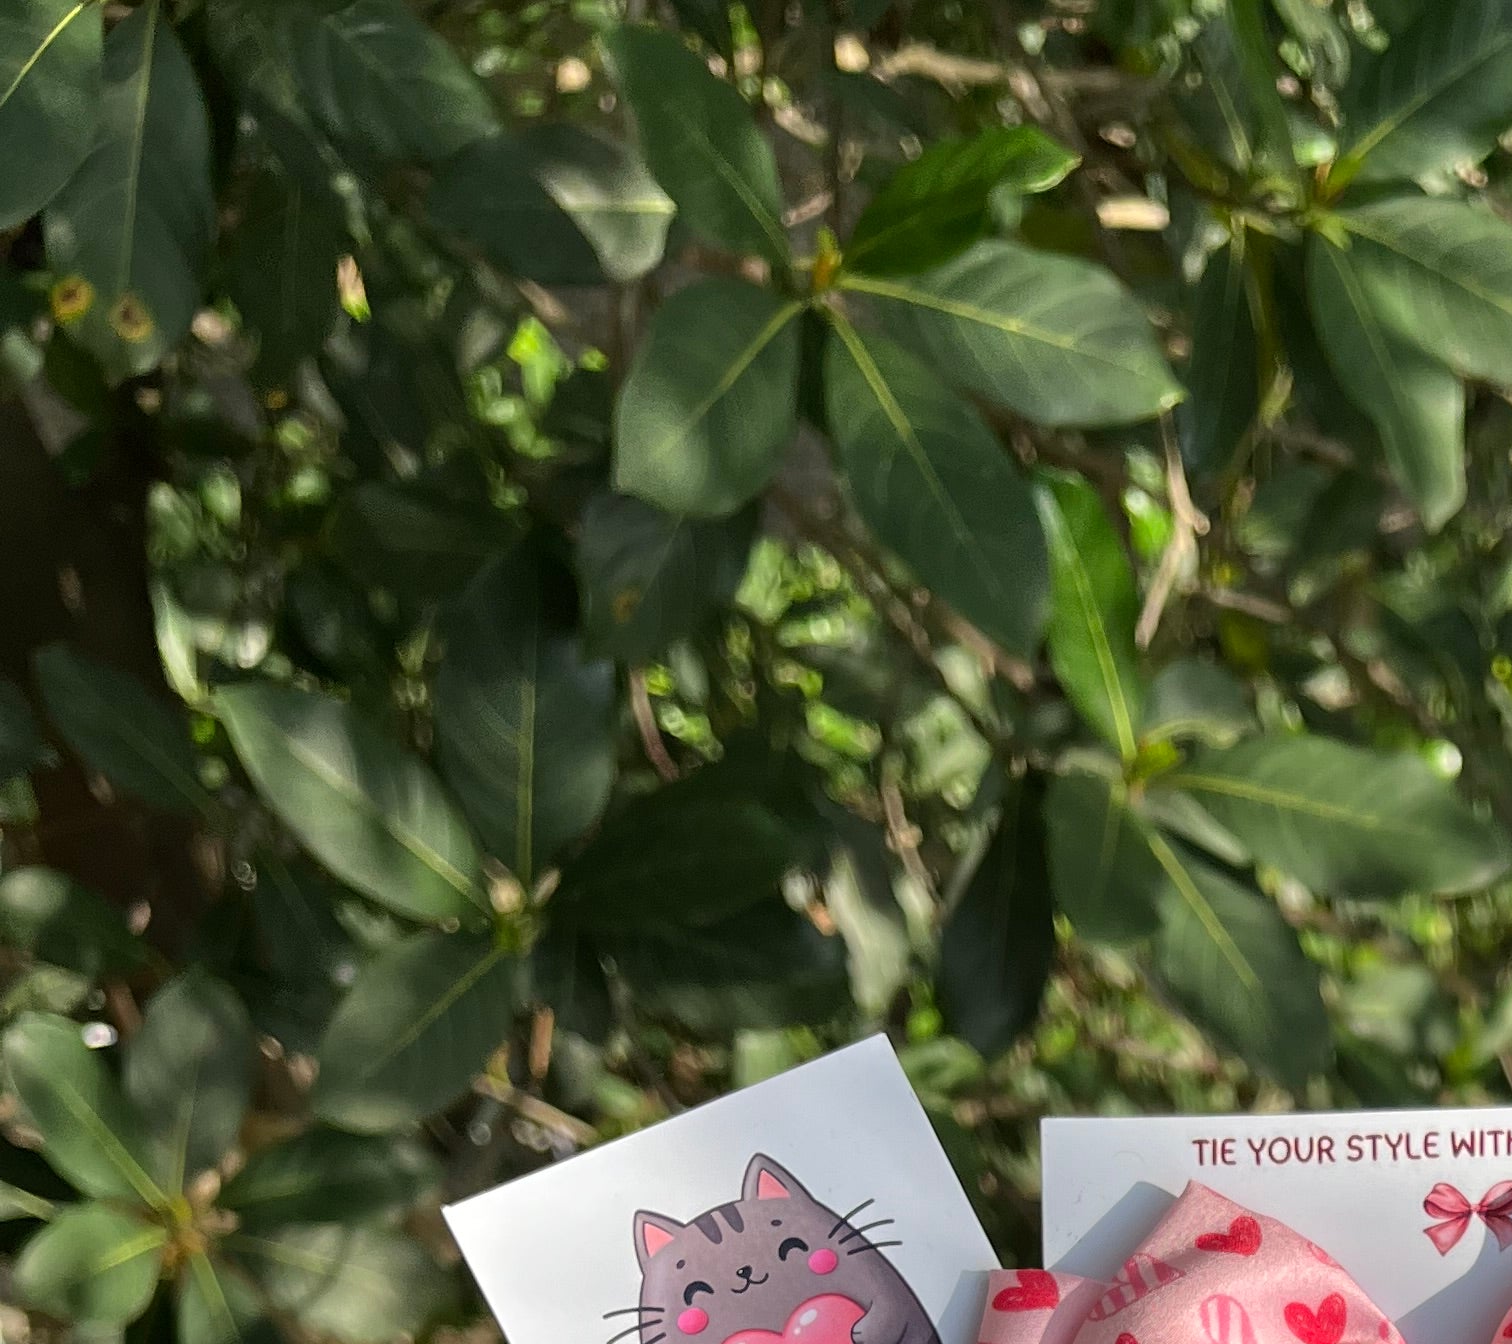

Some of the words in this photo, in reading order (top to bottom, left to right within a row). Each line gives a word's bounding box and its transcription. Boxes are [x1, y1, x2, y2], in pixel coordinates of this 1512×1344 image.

[1192, 1137, 1237, 1166] TIE
[1247, 1135, 1336, 1166] YOUR
[1346, 1131, 1440, 1162] STYLE
